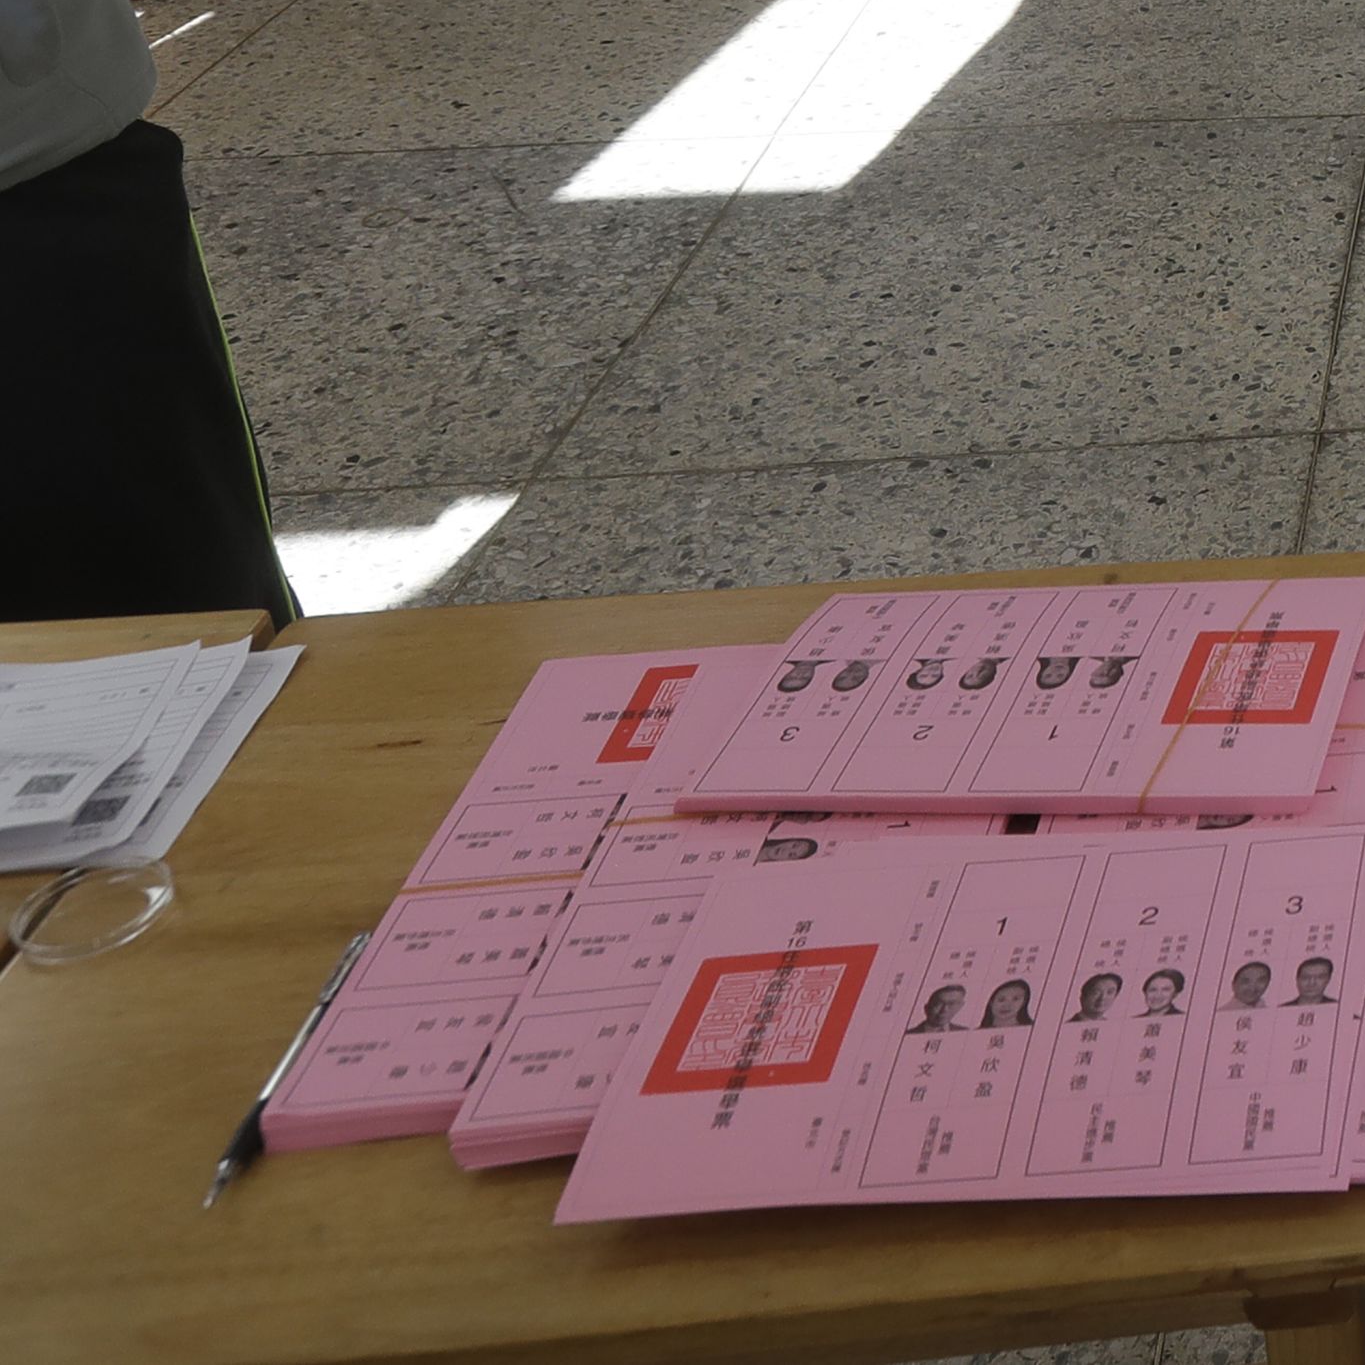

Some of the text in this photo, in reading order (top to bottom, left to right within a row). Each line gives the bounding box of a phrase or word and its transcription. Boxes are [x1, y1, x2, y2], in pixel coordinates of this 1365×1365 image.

[780, 725, 800, 742] 3
[912, 724, 935, 741] 2
[1047, 724, 1060, 741] 1
[1138, 906, 1160, 926] 2
[1284, 895, 1304, 915] 3
[996, 916, 1008, 936] 1
[1069, 1027, 1099, 1092] 賴清德
[1135, 1022, 1162, 1085] 蕭美琴
[1226, 1016, 1253, 1081] 侯友宜
[1289, 1012, 1315, 1076] 趙少康
[909, 1039, 943, 1103] 柯文哲
[973, 1034, 1005, 1099] 吳欣盈
